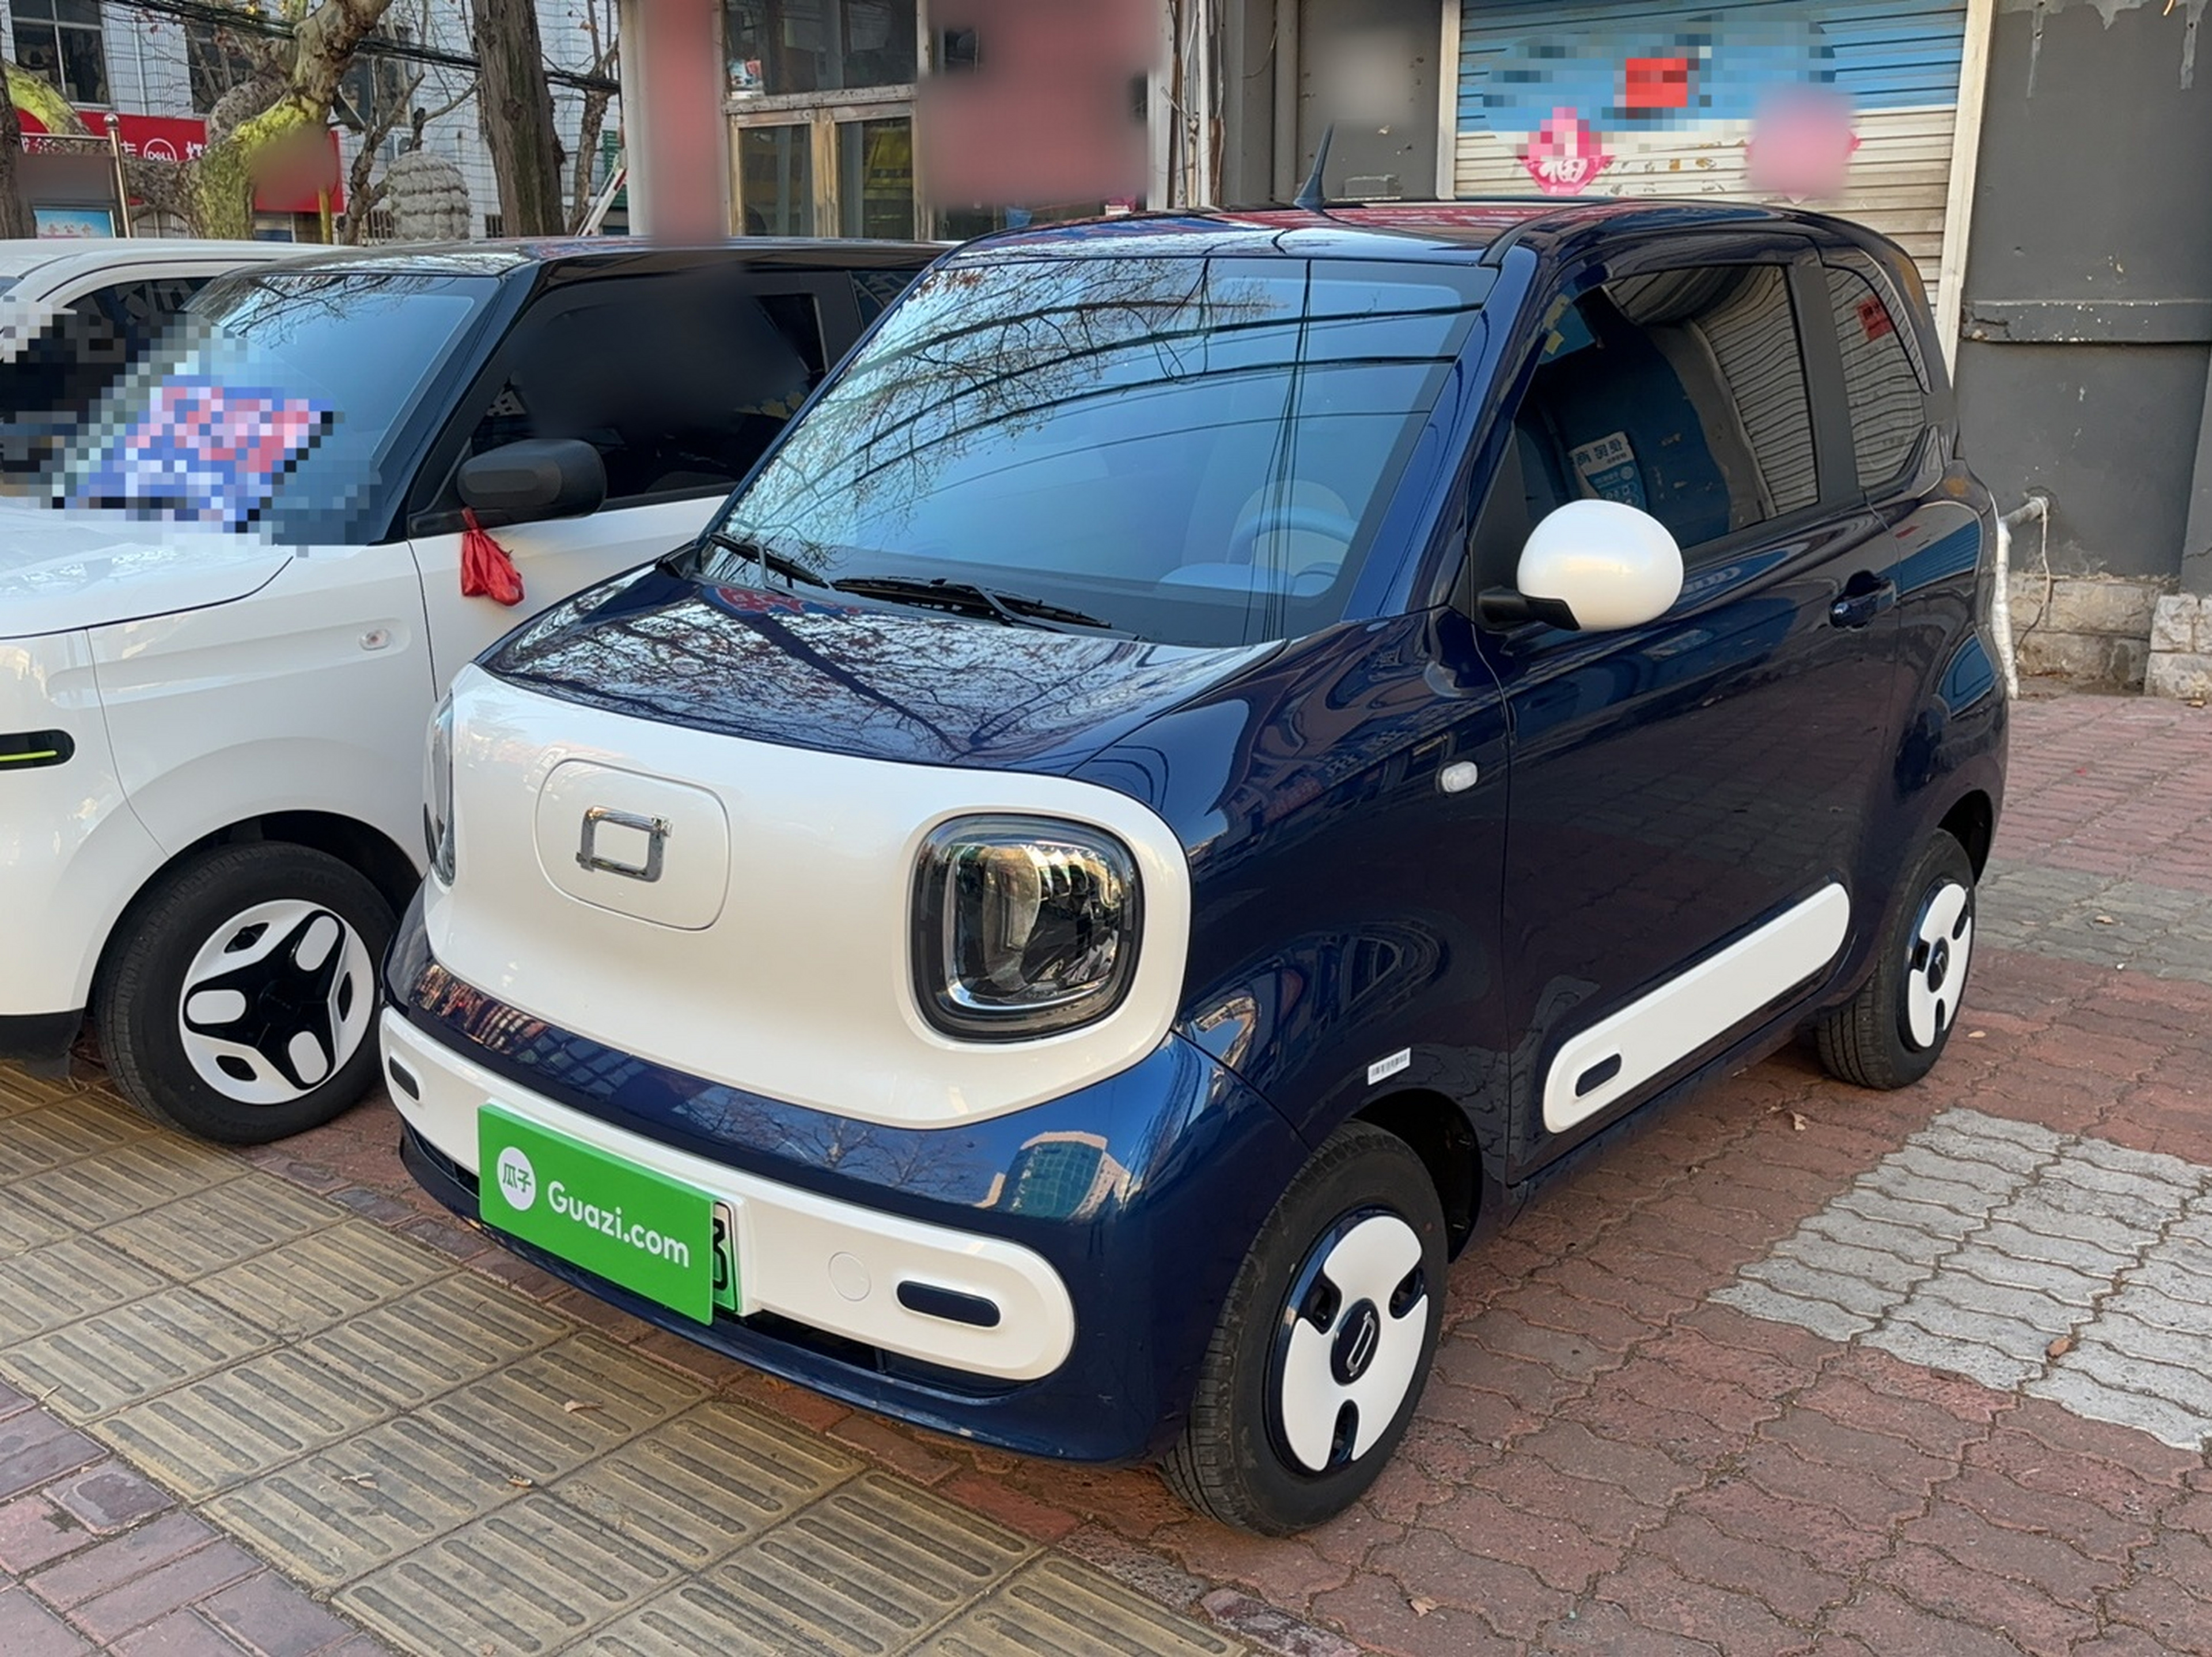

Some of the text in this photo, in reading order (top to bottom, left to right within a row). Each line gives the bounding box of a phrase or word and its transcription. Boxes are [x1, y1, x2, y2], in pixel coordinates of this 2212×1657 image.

[147, 151, 173, 161] DELL
[502, 1162, 689, 1268] 瓜子 Guazi.com
